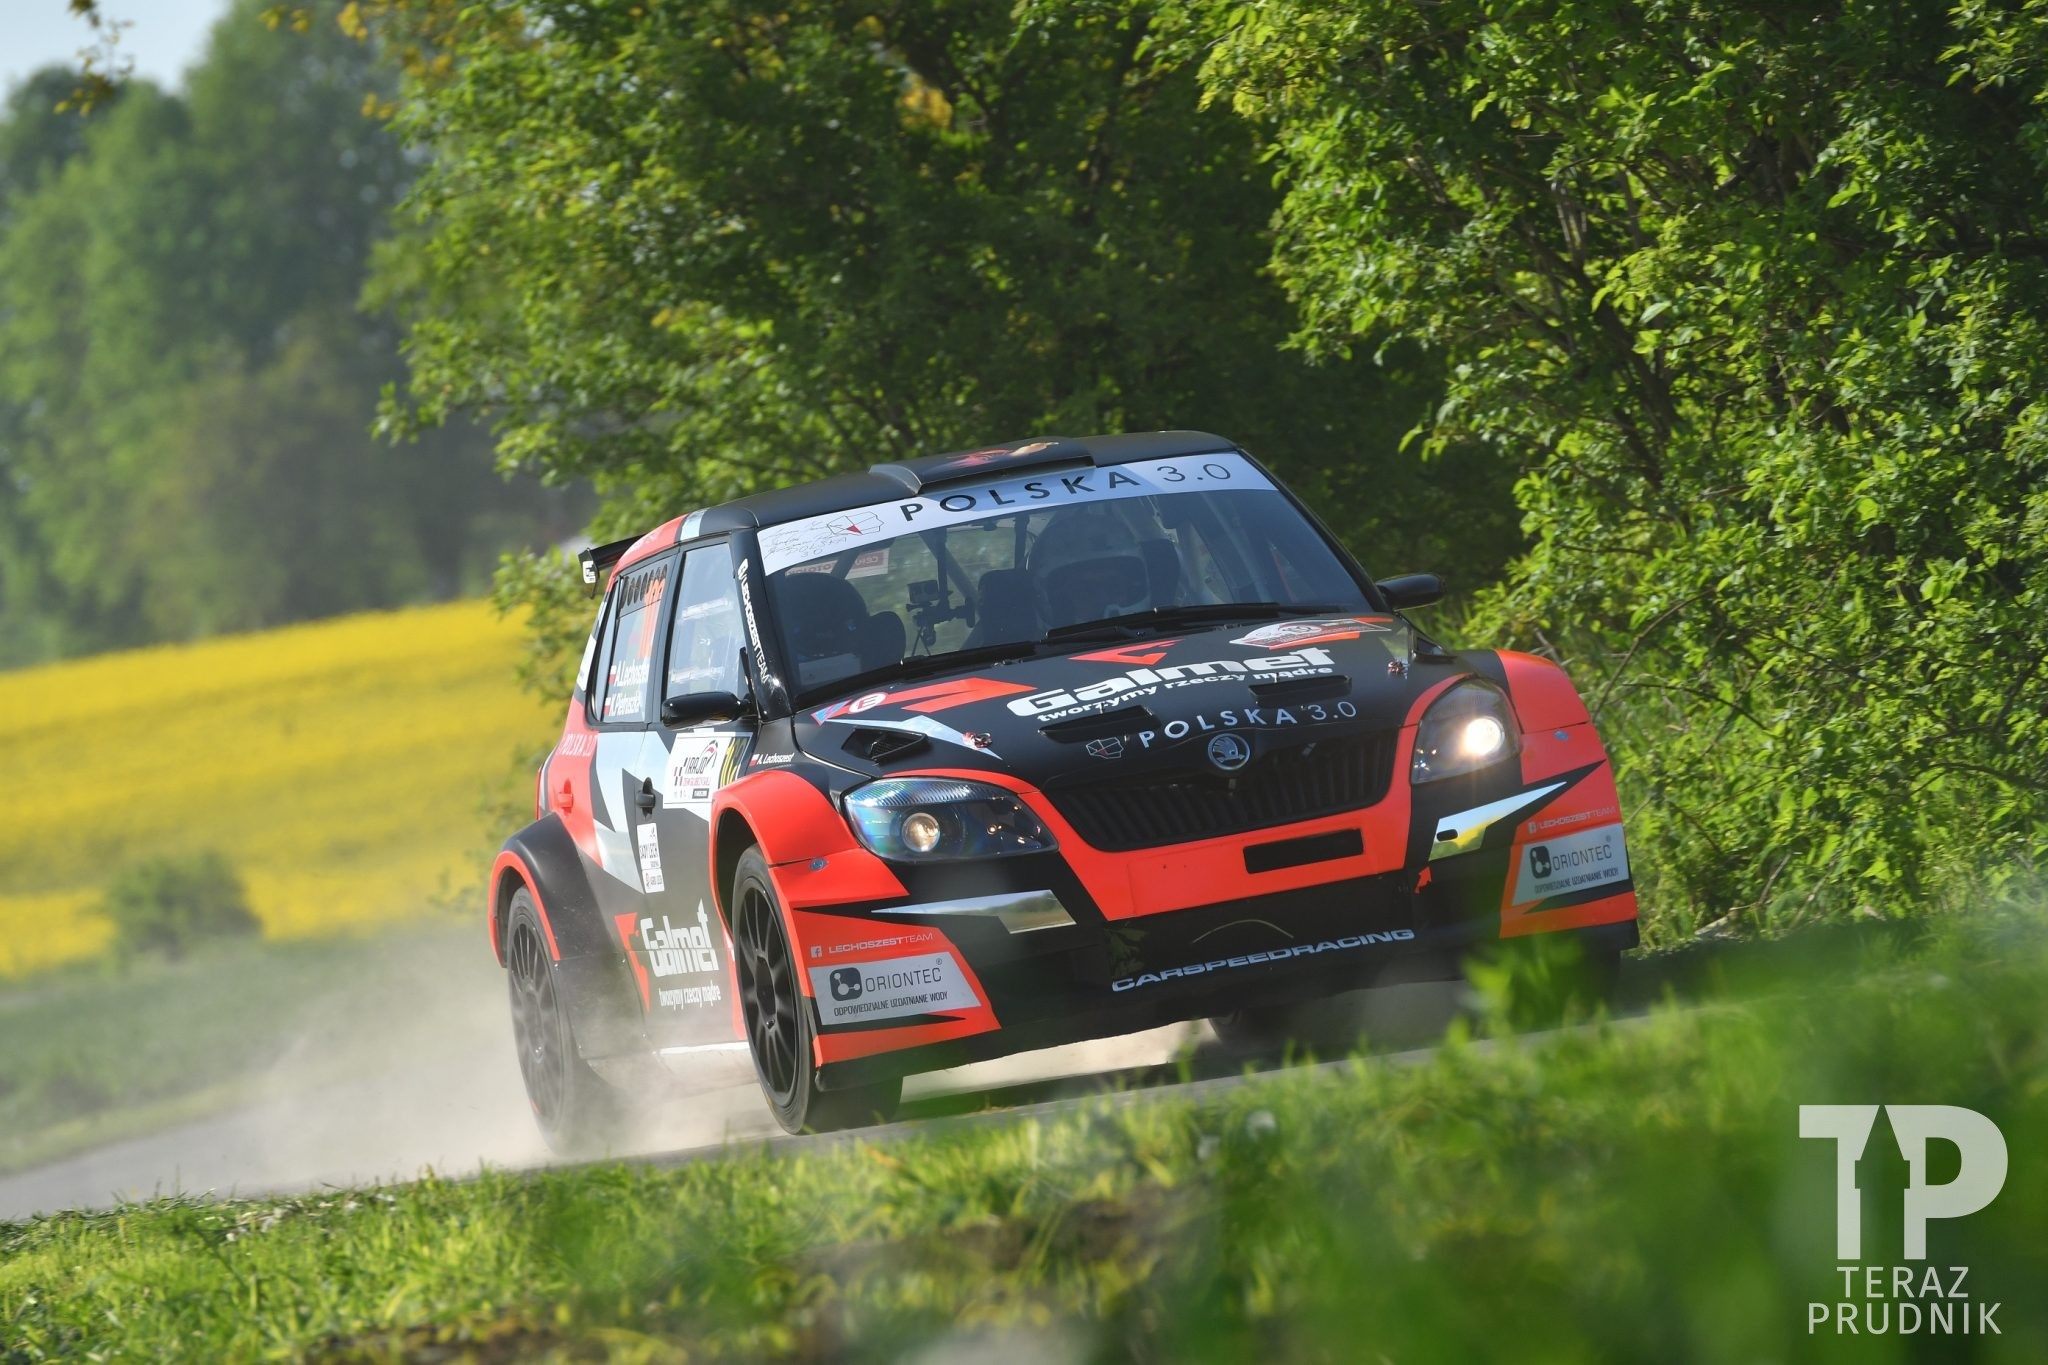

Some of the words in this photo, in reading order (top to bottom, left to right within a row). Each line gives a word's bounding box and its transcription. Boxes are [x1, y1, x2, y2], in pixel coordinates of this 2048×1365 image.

[900, 471, 1140, 522] POLSKA
[1157, 463, 1231, 482] 3.0
[1006, 647, 1335, 717] Galmet
[1037, 686, 1157, 722] tworzymy
[1164, 673, 1246, 690] rzeczy
[1138, 708, 1298, 749] POLSKA
[1307, 701, 1357, 721] 3.0
[1552, 844, 1612, 871] ORIONTEC
[828, 932, 933, 954] LECHOSZESTTEAM
[1111, 928, 1416, 993] CARSPEEDRACING
[833, 1000, 890, 1017] ODPOWIEDZIALNE
[890, 993, 928, 1008] UZDATNIANIE
[929, 991, 948, 1002] WODY
[865, 967, 942, 993] ORIONTEC
